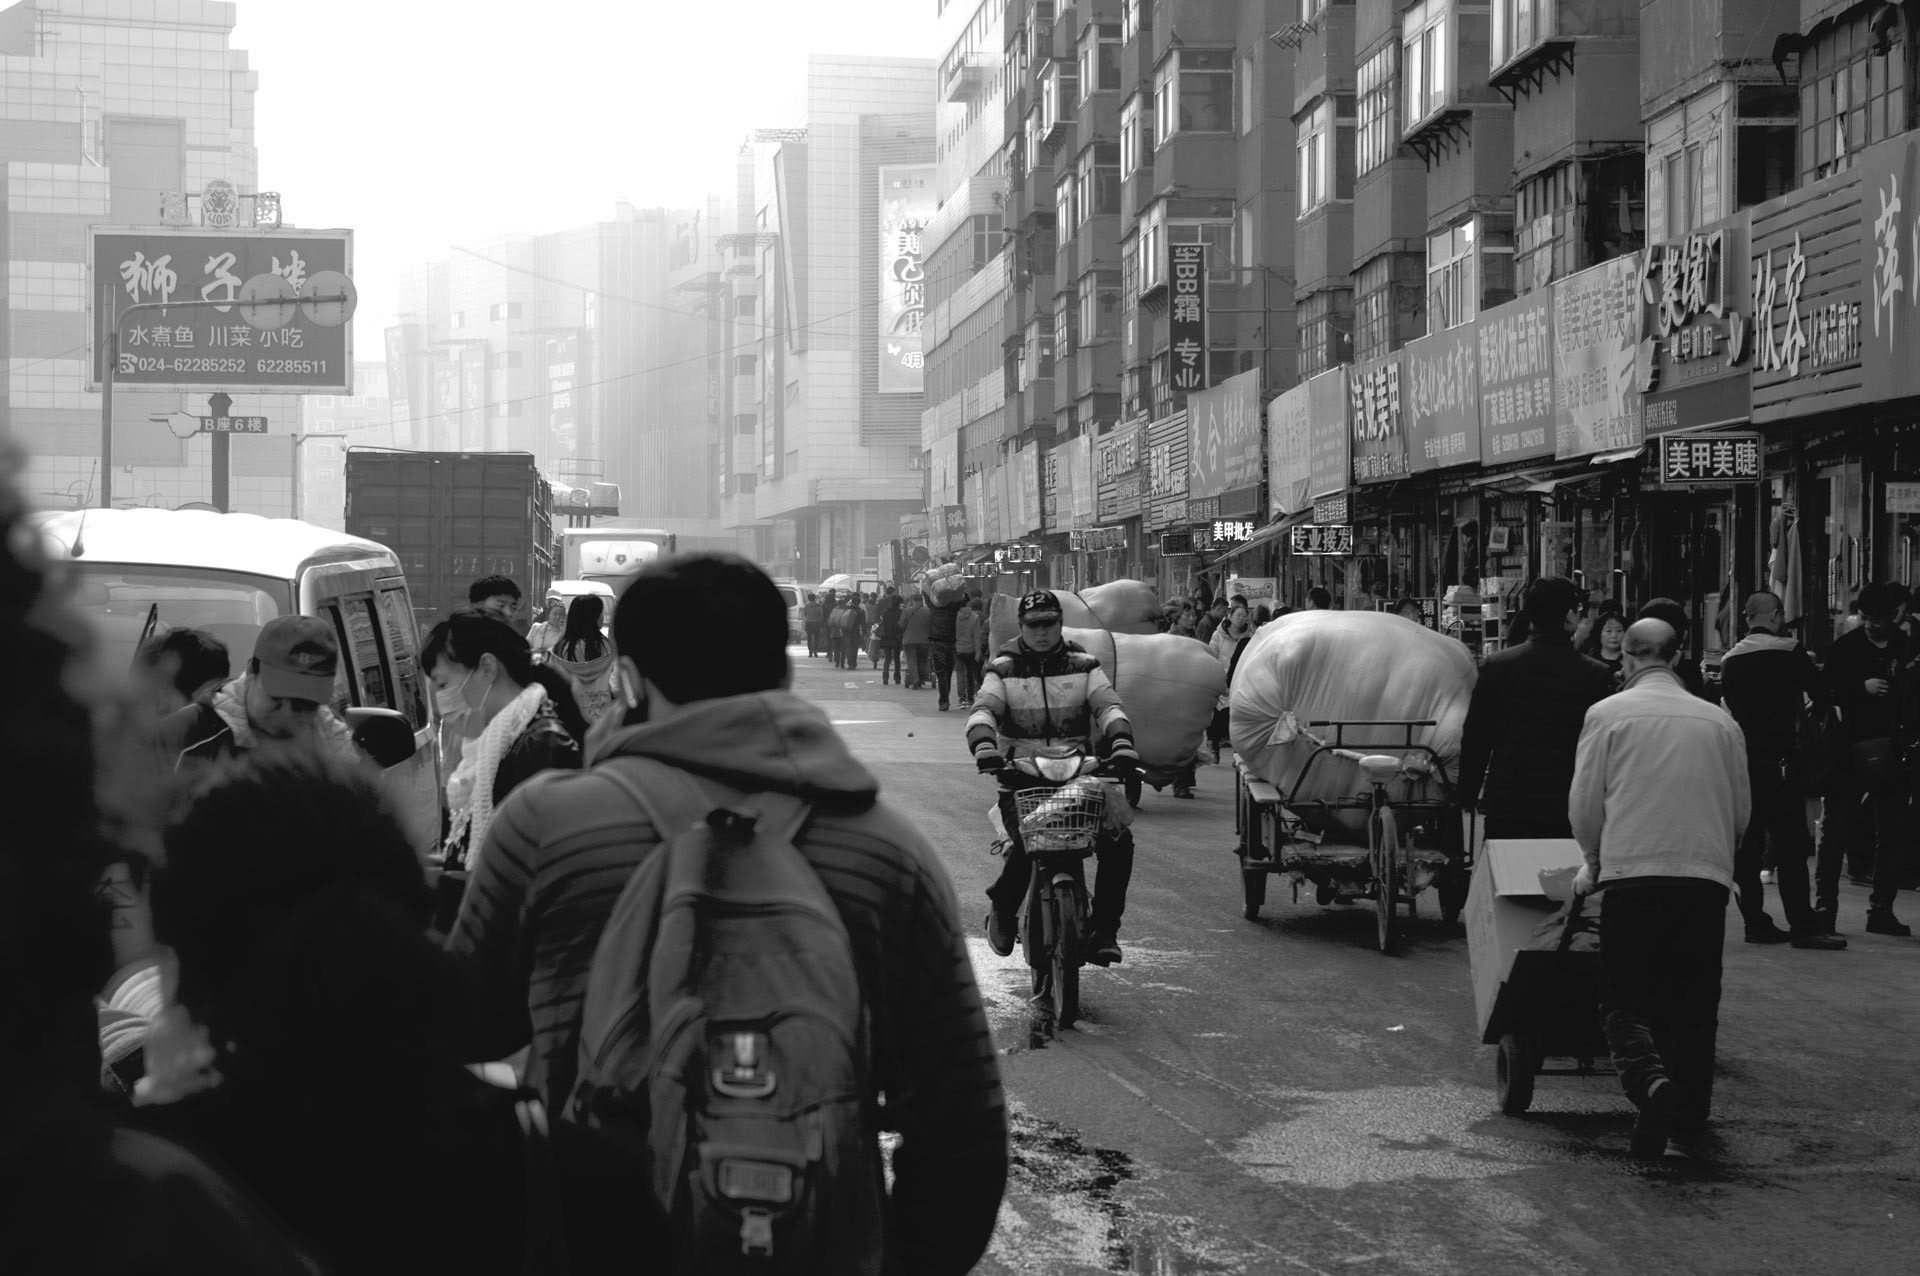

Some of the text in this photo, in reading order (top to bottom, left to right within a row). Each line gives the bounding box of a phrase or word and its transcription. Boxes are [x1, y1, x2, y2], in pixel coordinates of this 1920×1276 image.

[129, 325, 304, 349] 水煮鱼 川菜 小吃
[1809, 300, 1859, 369] 化妆品商行
[138, 358, 327, 374] 024-62285252 62285511
[204, 418, 263, 433] B座6楼
[1668, 440, 1758, 477] 美甲美睫
[1213, 520, 1255, 542] 美甲批发
[1293, 527, 1352, 552] 专业接发
[1024, 594, 1046, 610] 32
